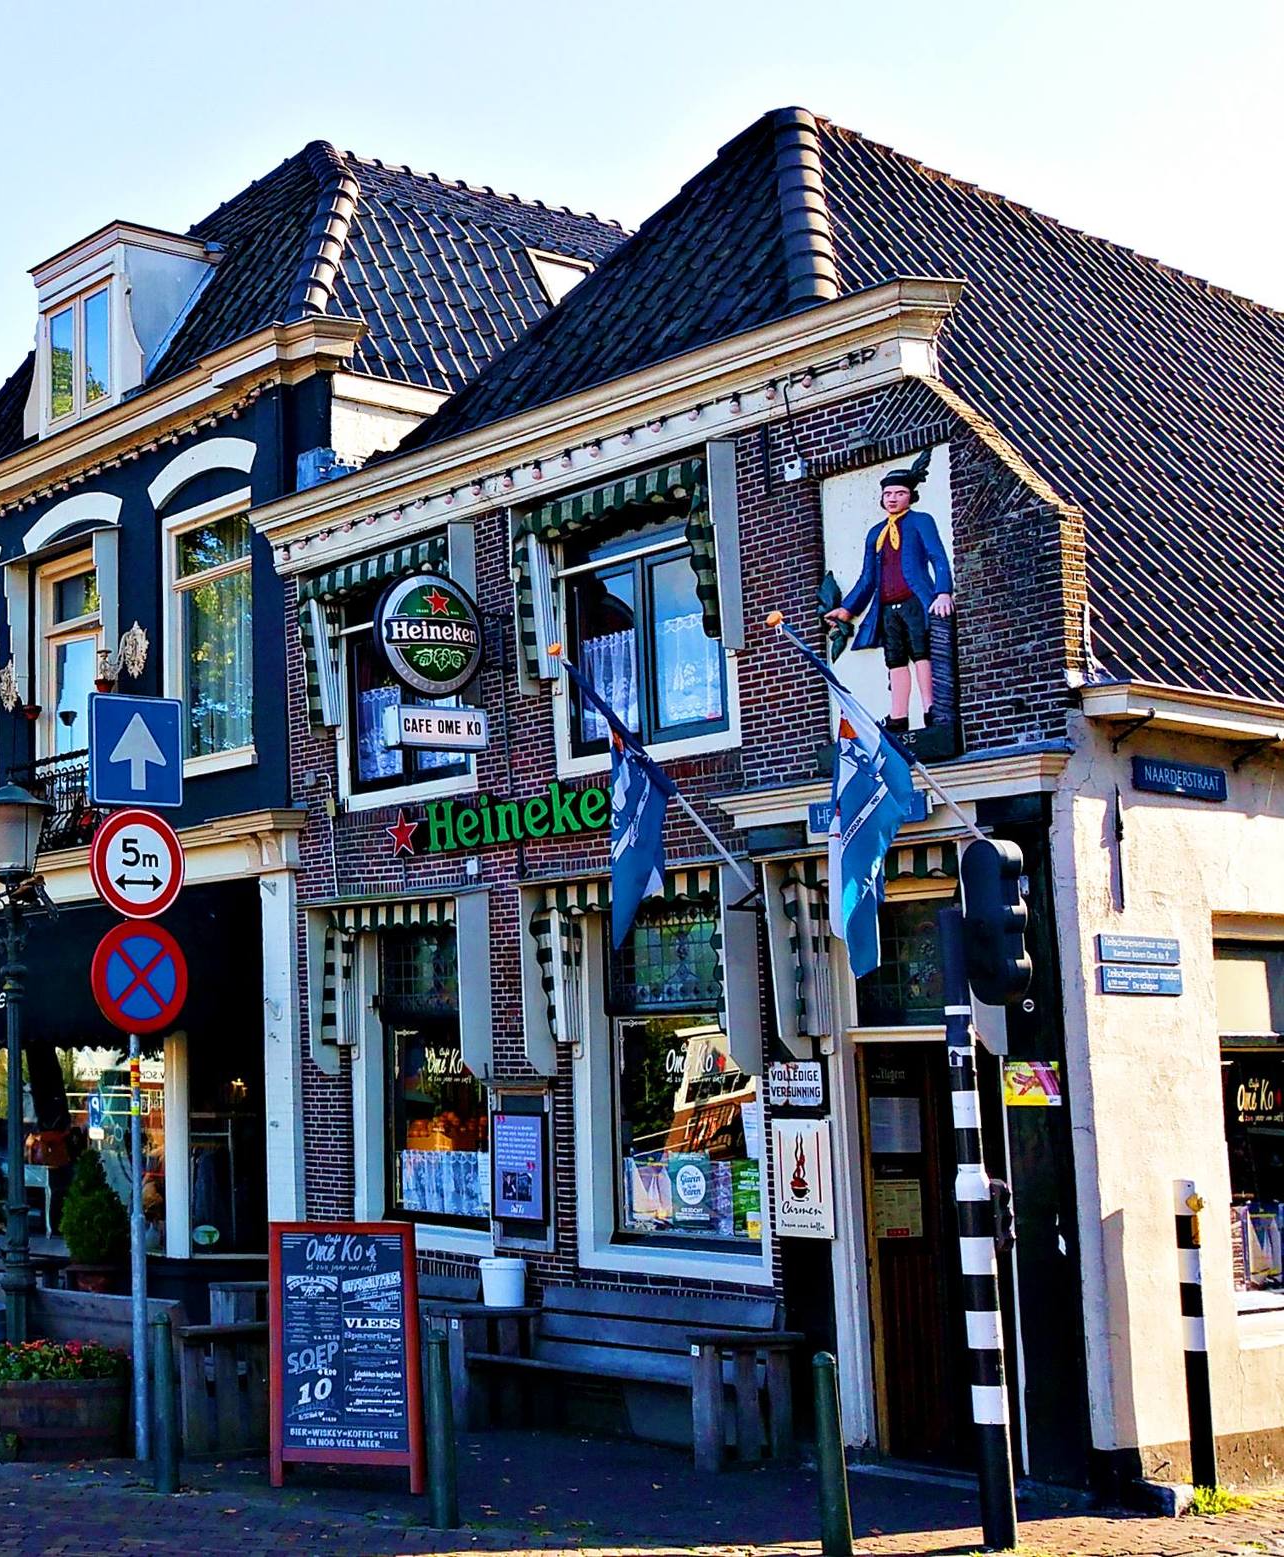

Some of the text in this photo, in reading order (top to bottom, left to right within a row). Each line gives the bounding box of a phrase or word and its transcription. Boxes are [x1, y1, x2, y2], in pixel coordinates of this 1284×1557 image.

[391, 621, 477, 644] Heineken
[404, 718, 481, 735] CAFE OME KO
[1144, 765, 1220, 791] NAARDERSTRAAT
[426, 782, 612, 851] Heineke
[122, 838, 159, 868] 5m
[666, 1049, 690, 1073] Ome
[771, 1070, 819, 1081] VOLLEDIGE
[771, 1086, 821, 1098] VERGUNNING
[1237, 1079, 1274, 1111] Ome Ko
[782, 1201, 822, 1215] Carmen
[306, 1235, 362, 1261] Ome Ko
[344, 1317, 401, 1329] VLEES
[287, 1341, 339, 1374] SOEP
[298, 1377, 333, 1405] 10
[306, 1438, 316, 1446] EN
[337, 1439, 355, 1447] VEEL
